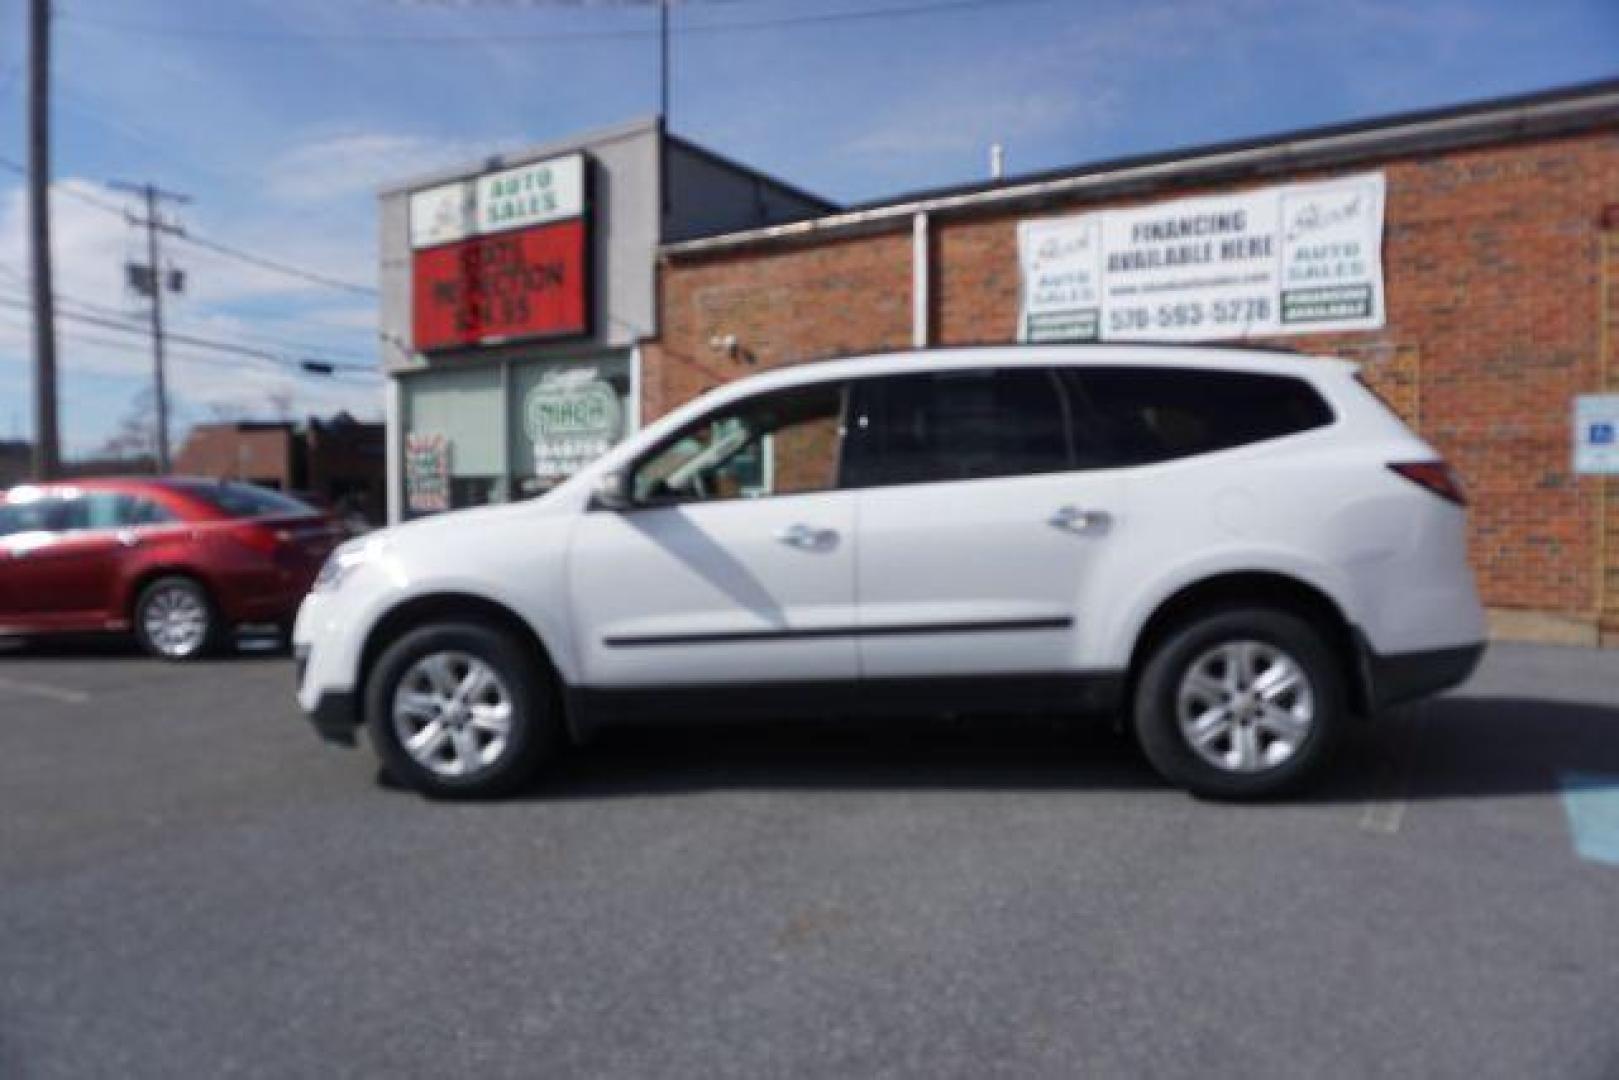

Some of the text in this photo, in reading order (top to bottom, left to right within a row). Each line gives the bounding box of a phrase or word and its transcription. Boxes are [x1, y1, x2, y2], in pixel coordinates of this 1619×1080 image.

[491, 168, 553, 197] AUTO
[486, 191, 558, 224] SALES
[1132, 210, 1247, 242] FINANCING
[1107, 241, 1211, 273] AVAILABLE
[1220, 233, 1272, 261] HERE
[1295, 241, 1362, 261] AUTO
